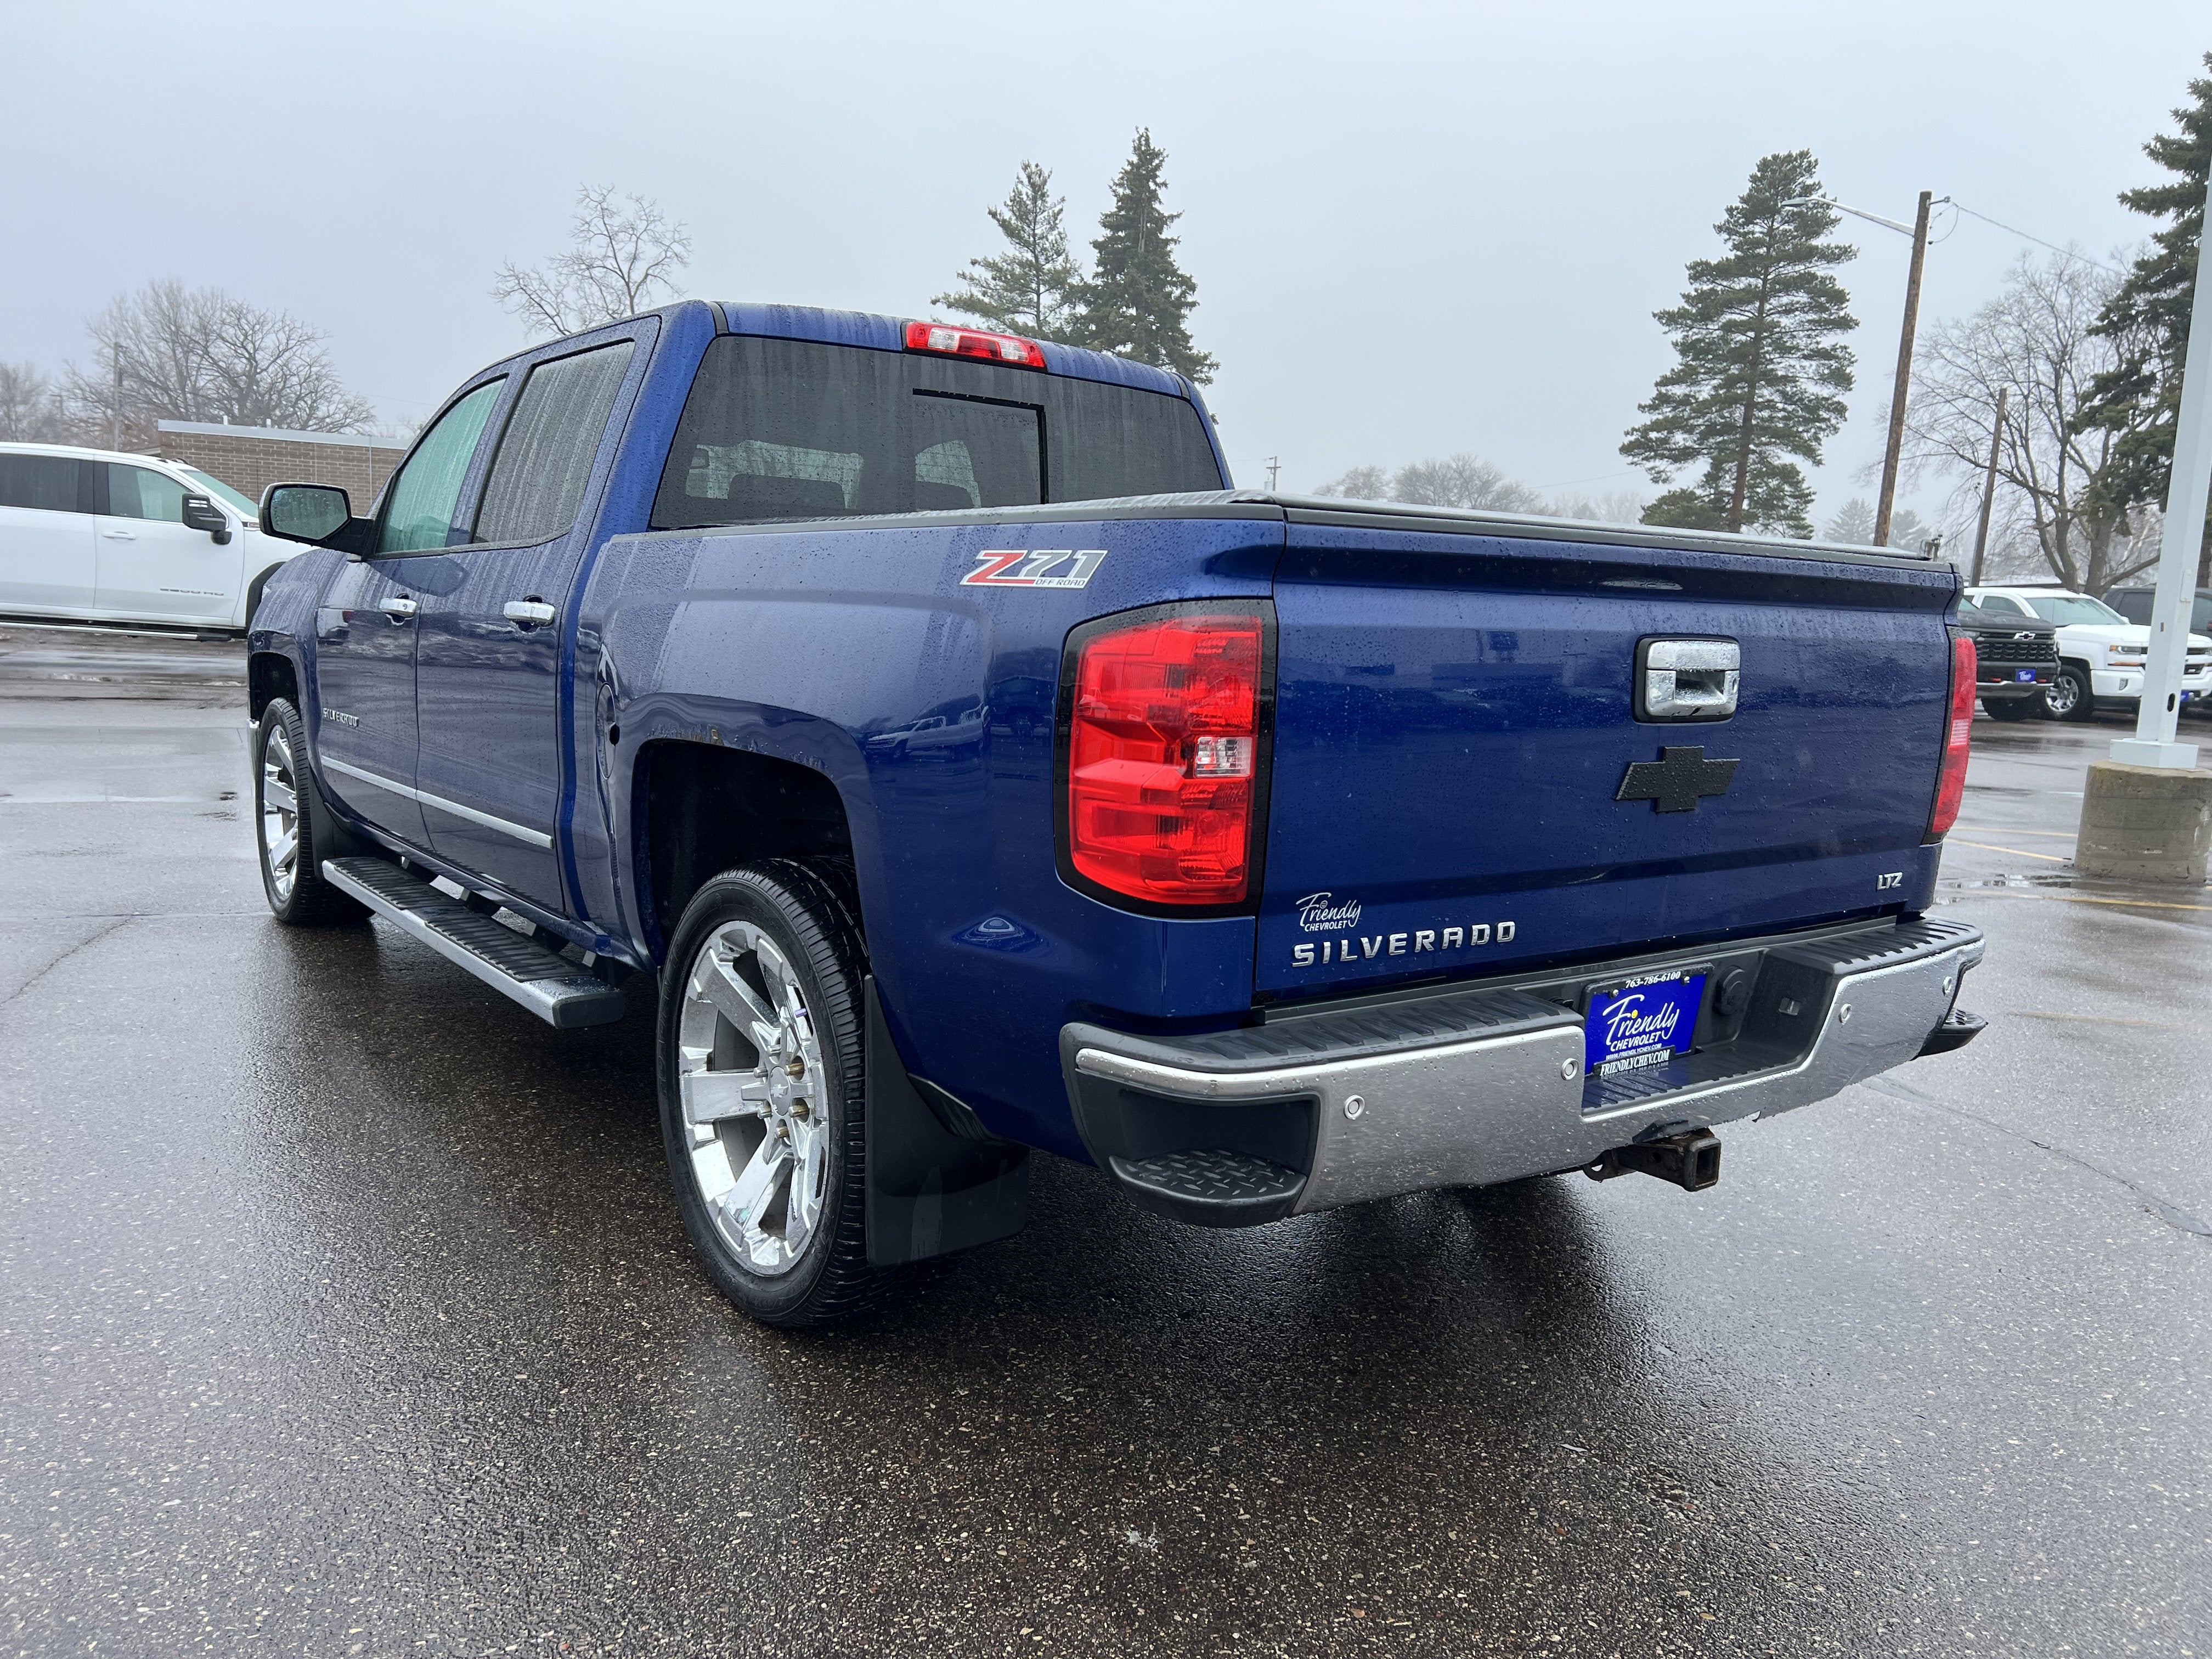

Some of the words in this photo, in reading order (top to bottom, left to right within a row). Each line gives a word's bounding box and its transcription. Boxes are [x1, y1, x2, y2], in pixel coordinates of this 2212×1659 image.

[960, 550, 1108, 586] Z71
[1877, 872, 1903, 890] LTZ
[1296, 892, 1362, 927] Friendly
[1304, 920, 1348, 932] CHEVROLET
[1291, 921, 1515, 967] SILVERADO
[1625, 970, 1681, 989] 763-786-6100
[1602, 994, 1680, 1045] Friendly
[1610, 1031, 1662, 1052] CHEVROLET
[1599, 1049, 1671, 1076] FRIENDLYCHEV.COM
